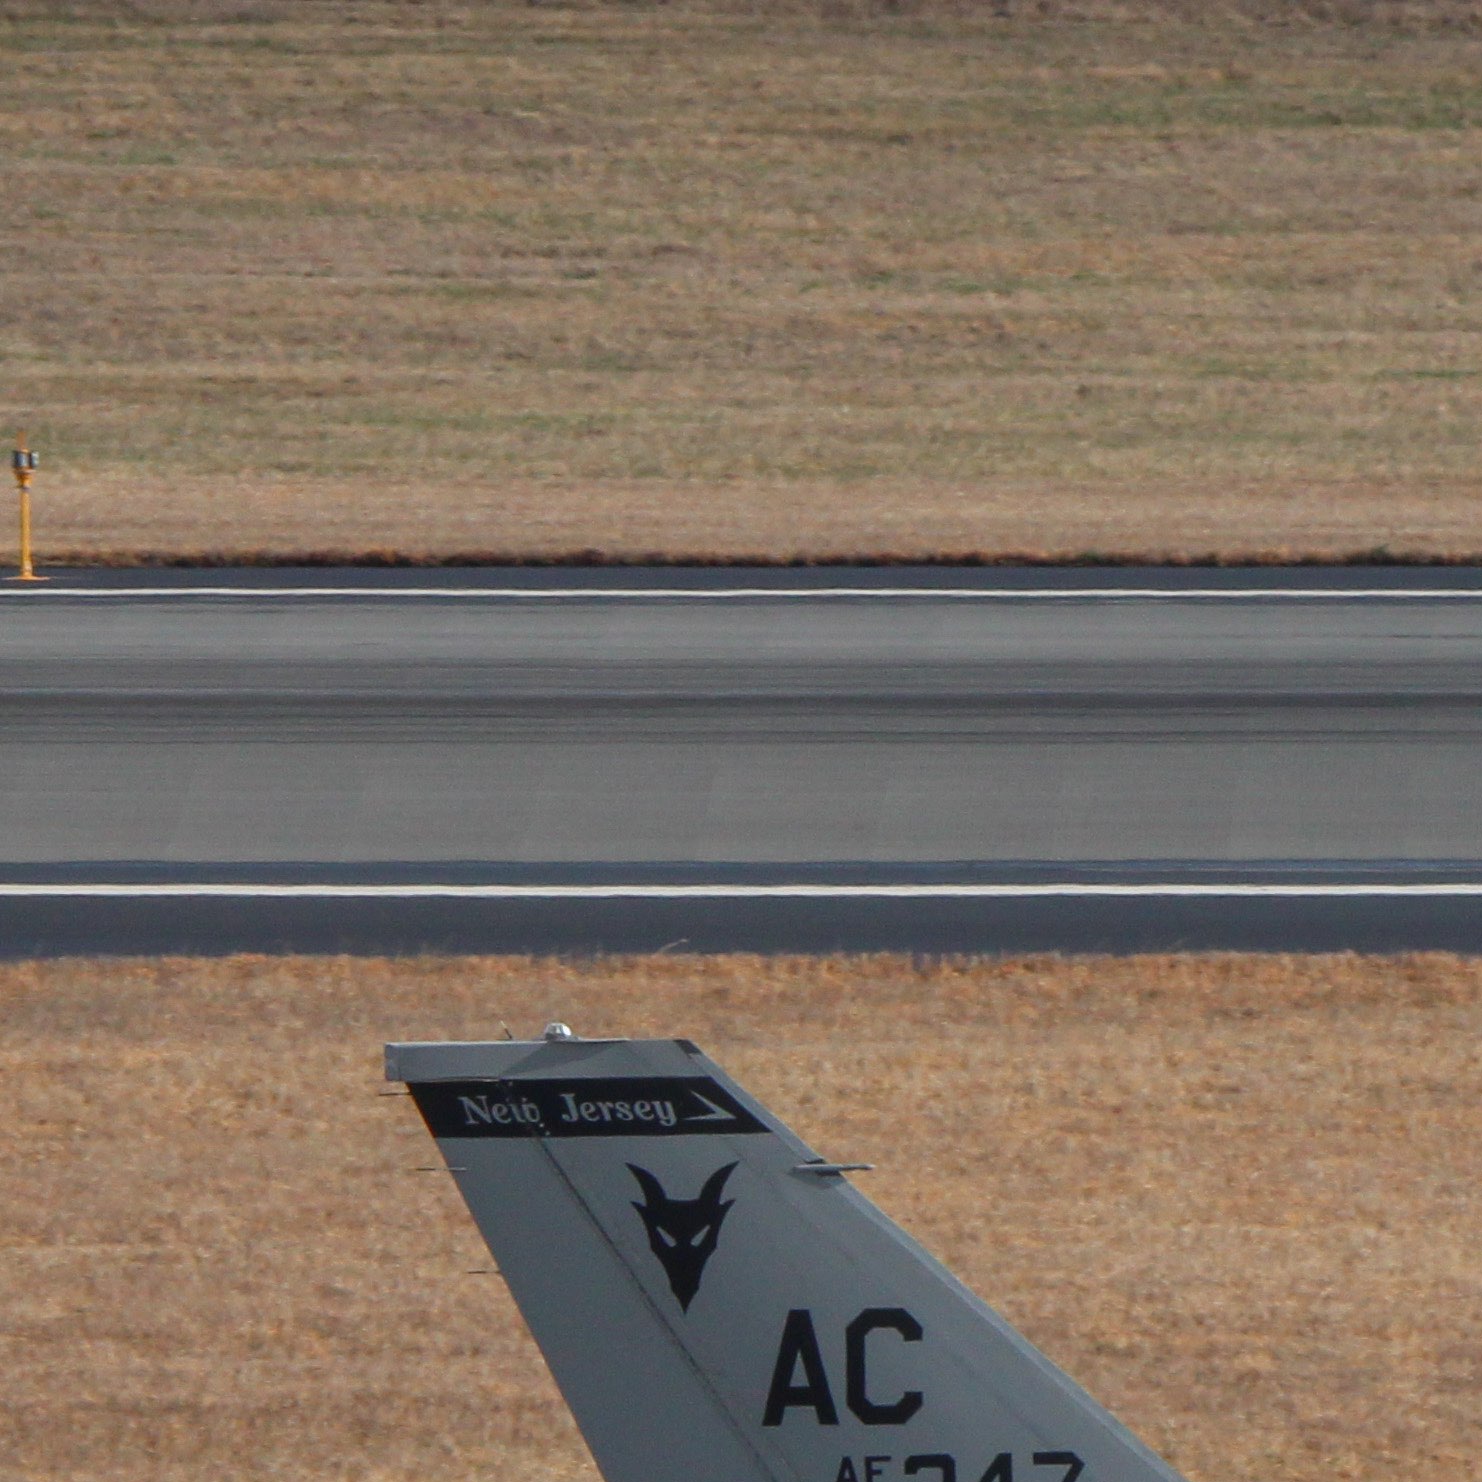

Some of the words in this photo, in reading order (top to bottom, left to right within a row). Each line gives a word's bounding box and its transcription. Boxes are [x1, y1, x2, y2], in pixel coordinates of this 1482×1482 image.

[458, 1095, 541, 1125] New
[559, 1093, 677, 1126] Jersey
[762, 1307, 924, 1427] AC
